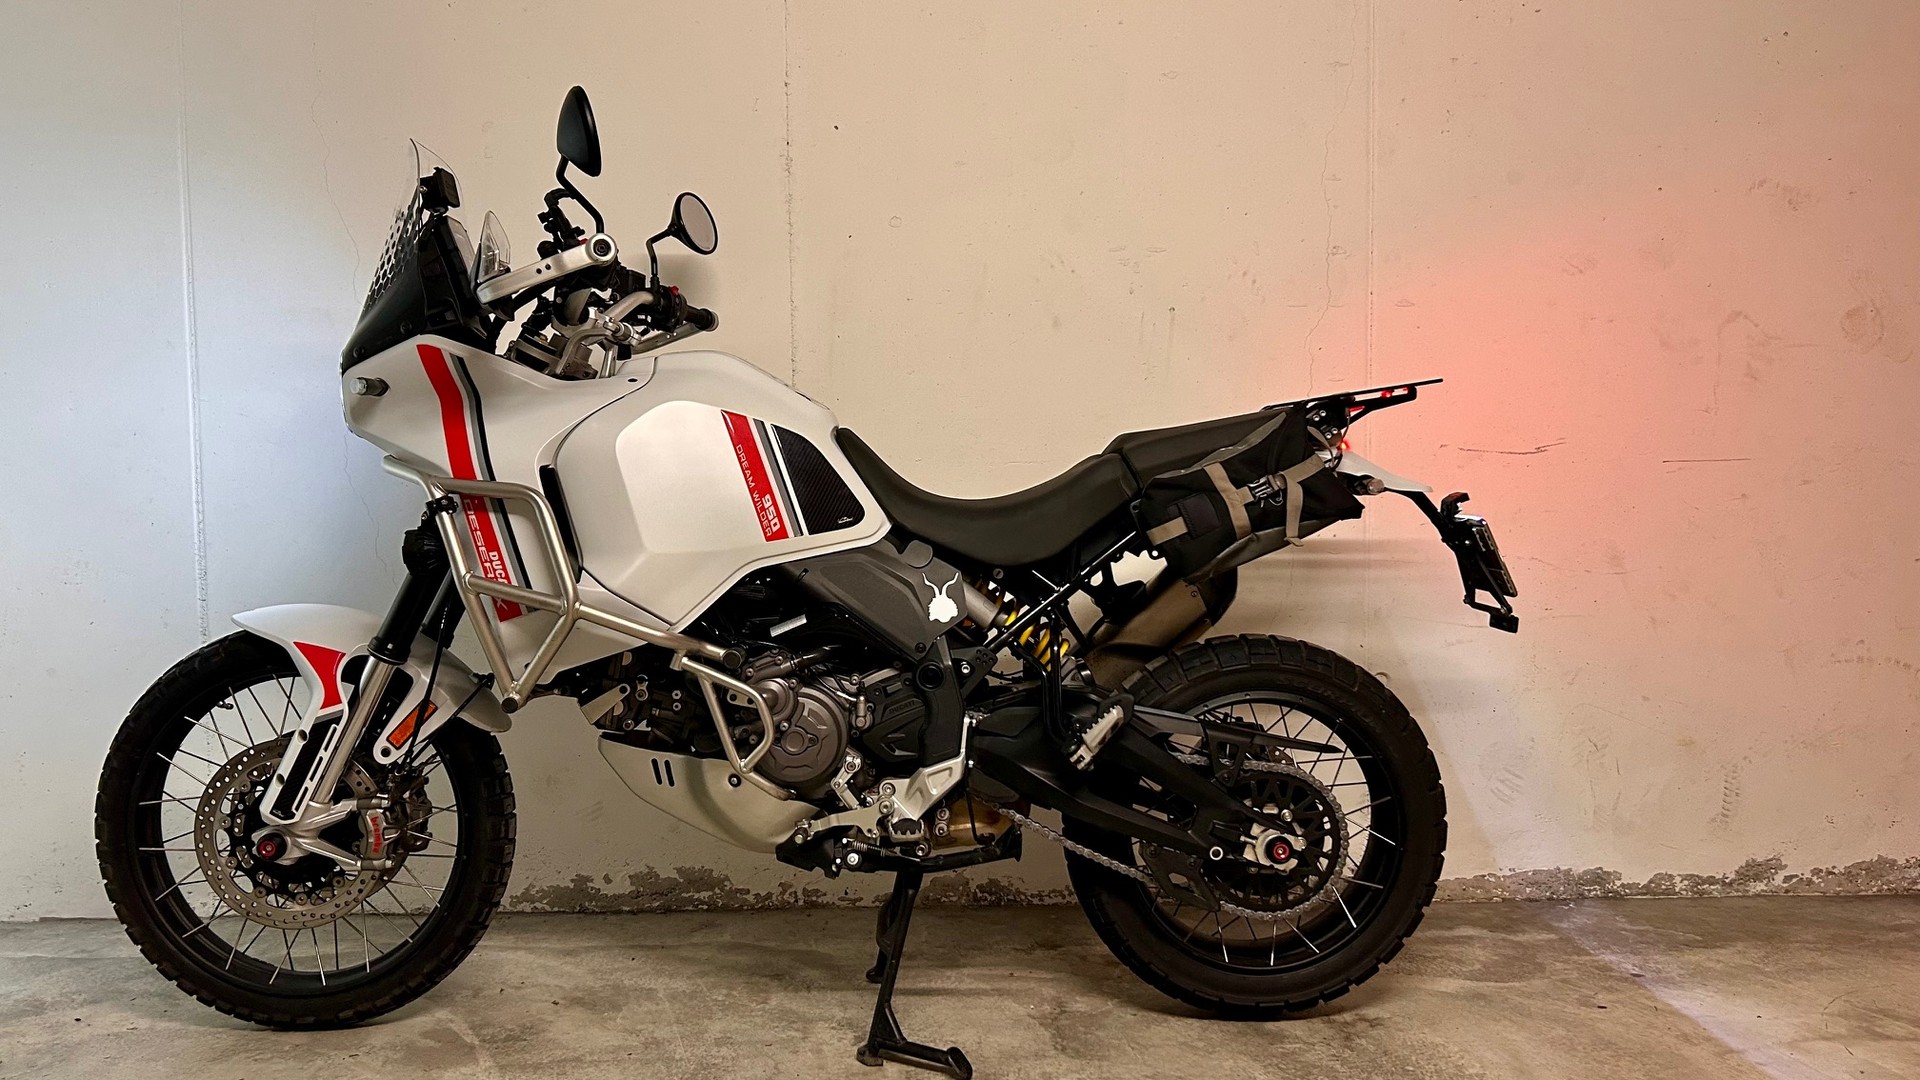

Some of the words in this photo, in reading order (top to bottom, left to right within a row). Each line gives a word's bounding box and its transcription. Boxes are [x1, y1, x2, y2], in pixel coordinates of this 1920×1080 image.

[736, 444, 755, 488] DREAM
[753, 490, 772, 537] WILDER
[762, 494, 781, 533] 950
